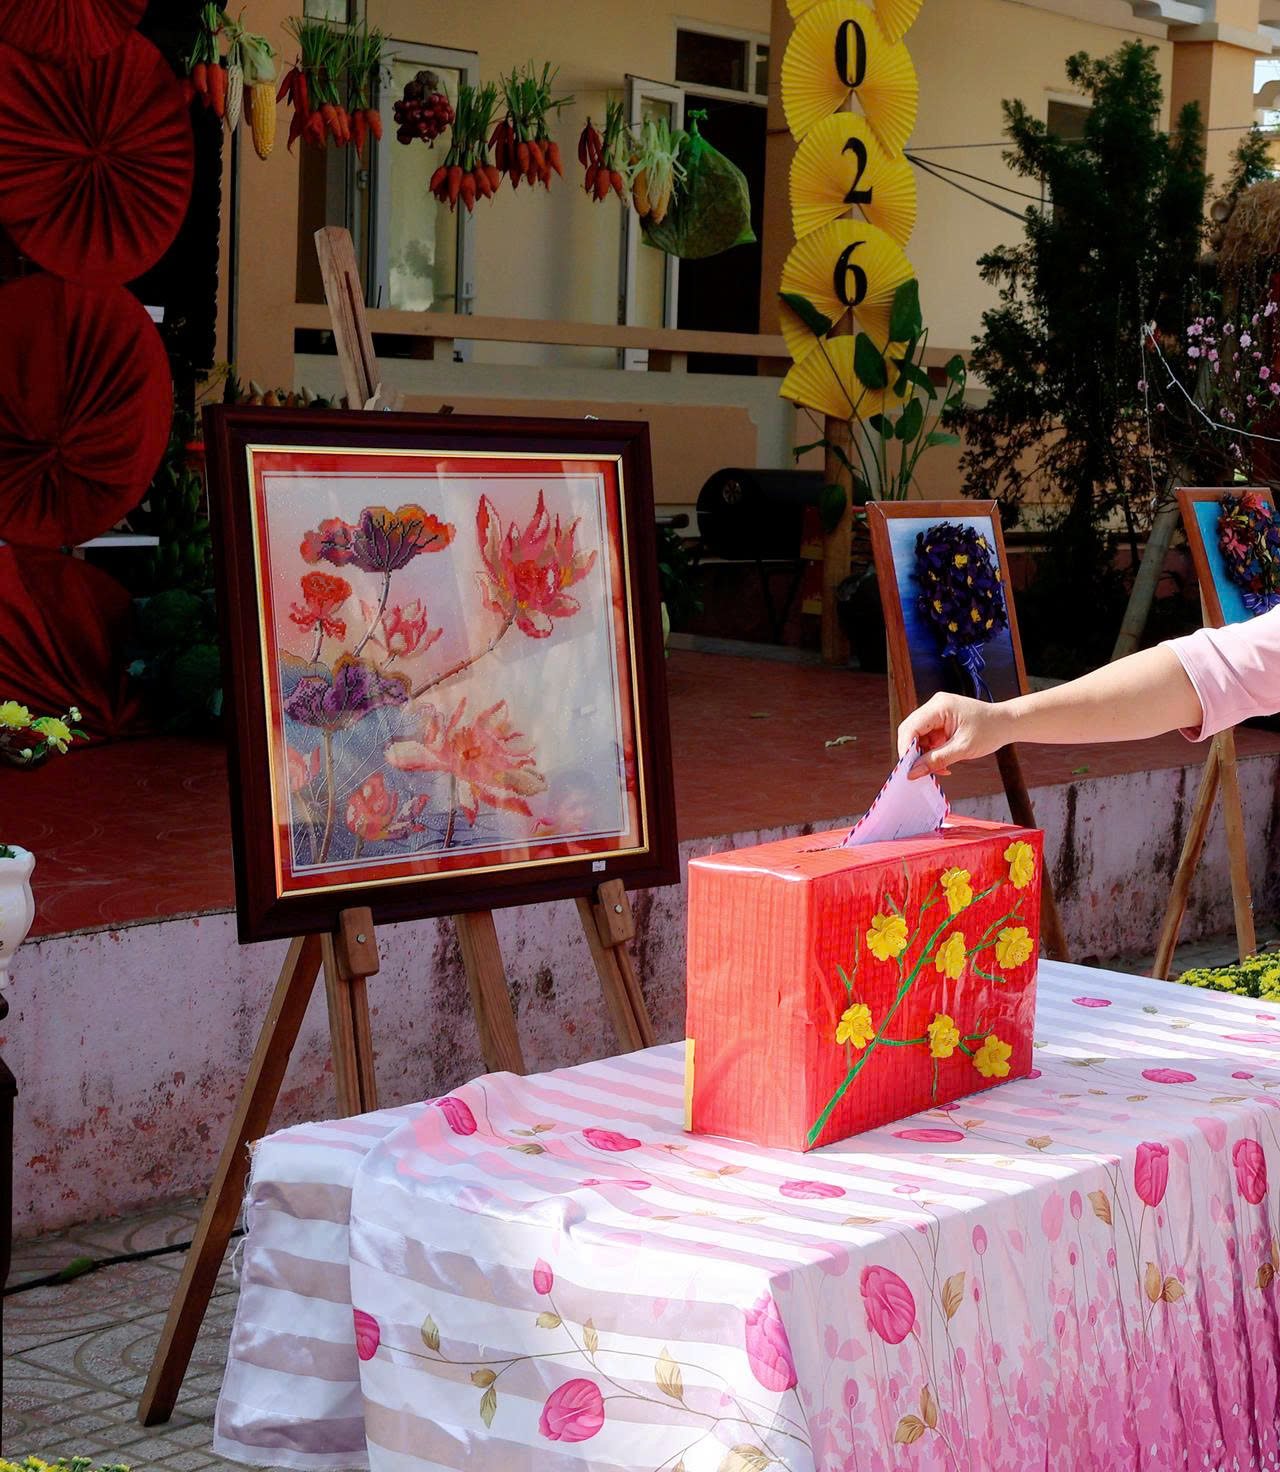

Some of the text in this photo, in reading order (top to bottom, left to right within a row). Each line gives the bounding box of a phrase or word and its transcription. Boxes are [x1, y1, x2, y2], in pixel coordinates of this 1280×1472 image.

[835, 19, 867, 88] 0
[841, 137, 873, 204] 2
[833, 241, 868, 307] 6
